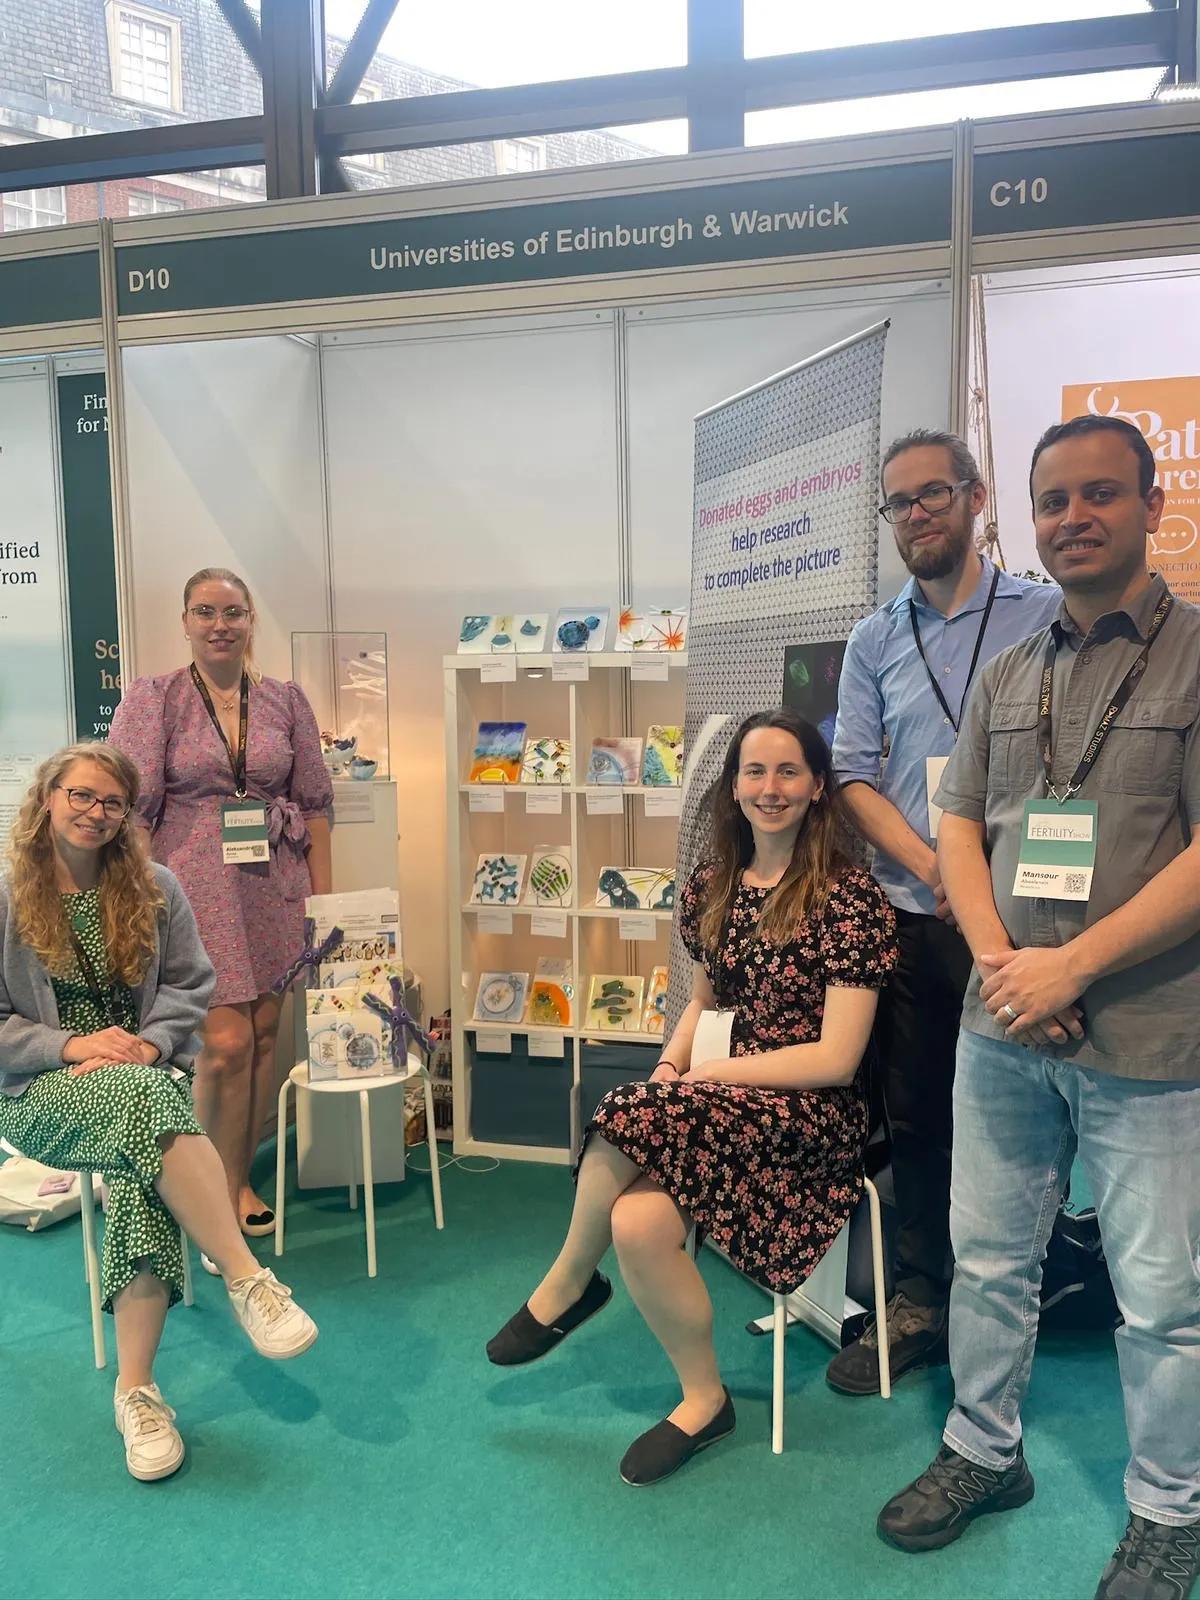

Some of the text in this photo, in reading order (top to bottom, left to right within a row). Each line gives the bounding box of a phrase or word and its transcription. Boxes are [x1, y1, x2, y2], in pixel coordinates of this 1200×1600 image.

[990, 177, 1048, 207] C10
[370, 201, 849, 270] Universities of Edinburgh & Warwick
[128, 267, 170, 293] D10
[76, 417, 100, 433] for
[1153, 468, 1200, 490] re
[700, 461, 863, 528] Donated eggs and embryos
[731, 511, 811, 554] help research
[0, 569, 38, 585] rom
[705, 547, 841, 591] to complete the picture
[95, 639, 120, 660] Sc
[99, 704, 113, 716] to
[1083, 730, 1104, 763] STUDIOS
[1031, 826, 1074, 838] FERTILITY
[1022, 871, 1060, 879] Mansour
